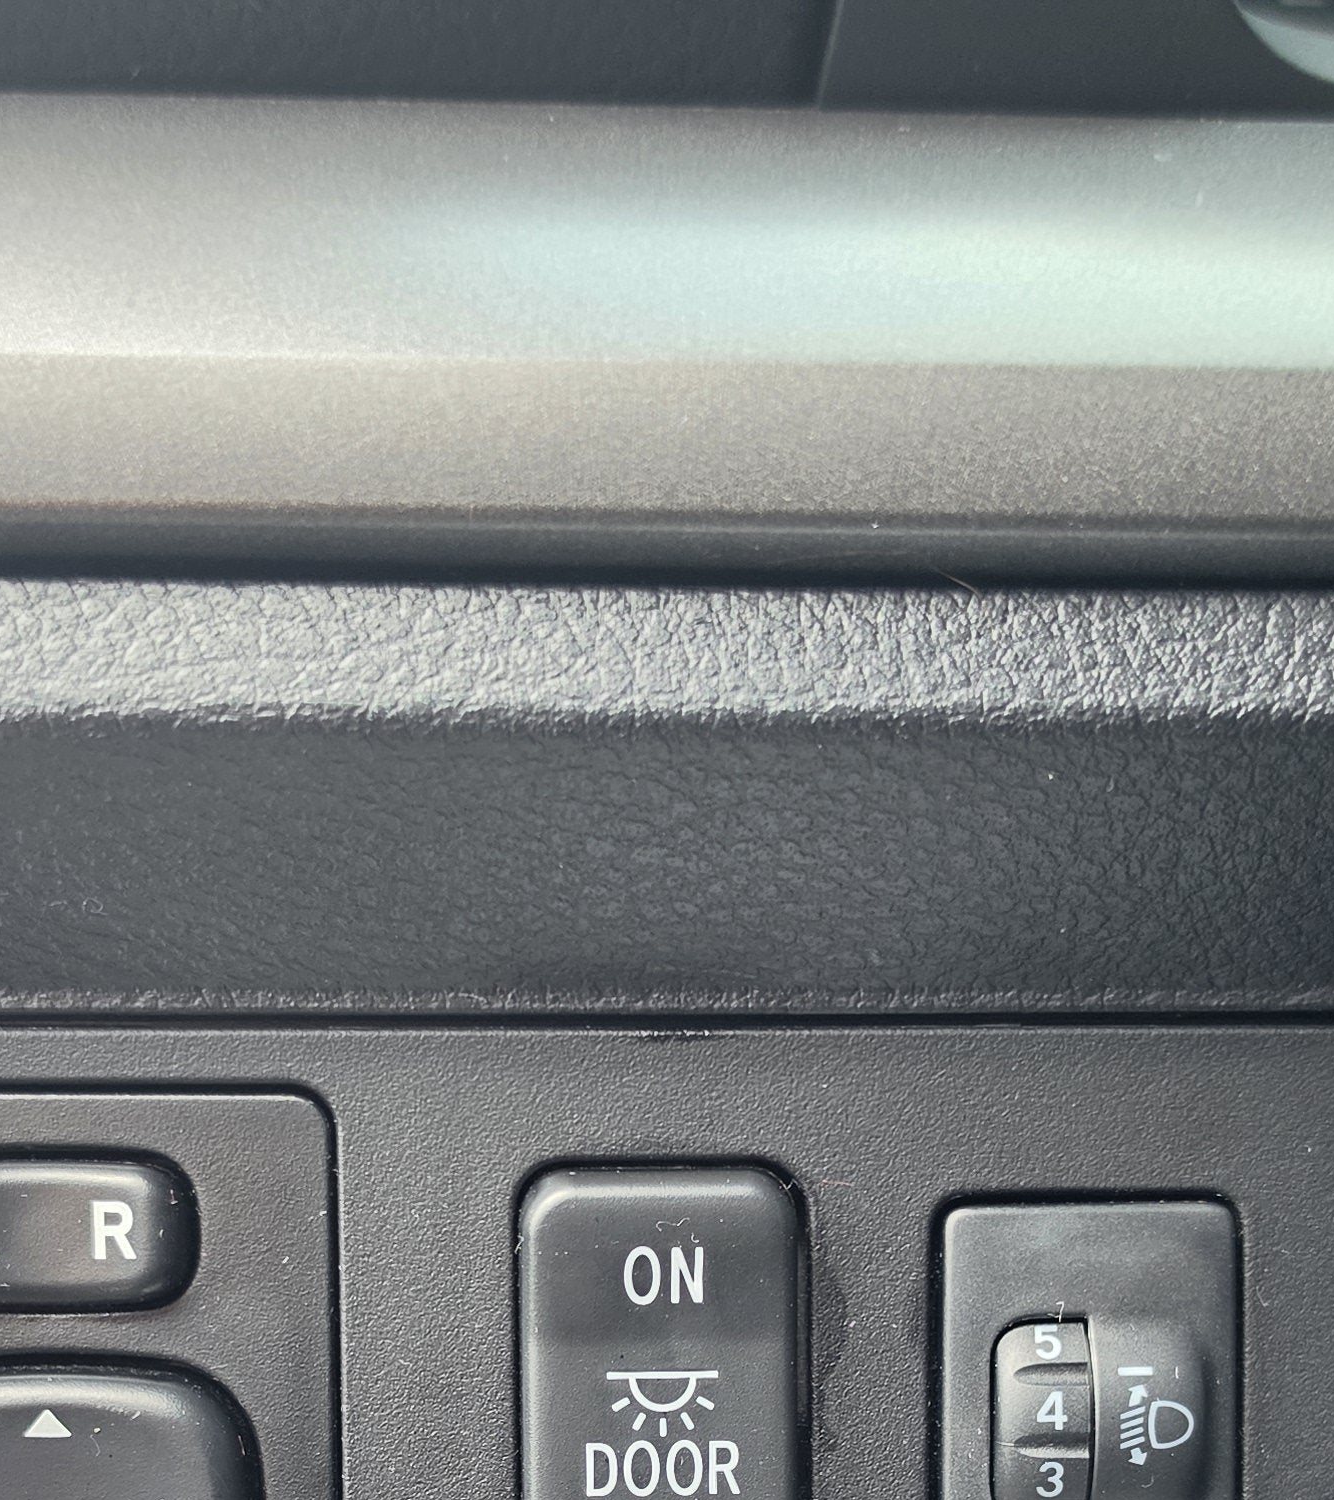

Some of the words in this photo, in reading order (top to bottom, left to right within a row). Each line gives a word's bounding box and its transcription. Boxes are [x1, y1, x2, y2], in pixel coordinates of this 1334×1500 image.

[91, 1200, 137, 1261] R
[623, 1245, 705, 1306] ON
[1033, 1323, 1063, 1361] 5
[1035, 1390, 1068, 1432] 4
[584, 1438, 741, 1498] DOOR
[1035, 1461, 1065, 1499] 3
